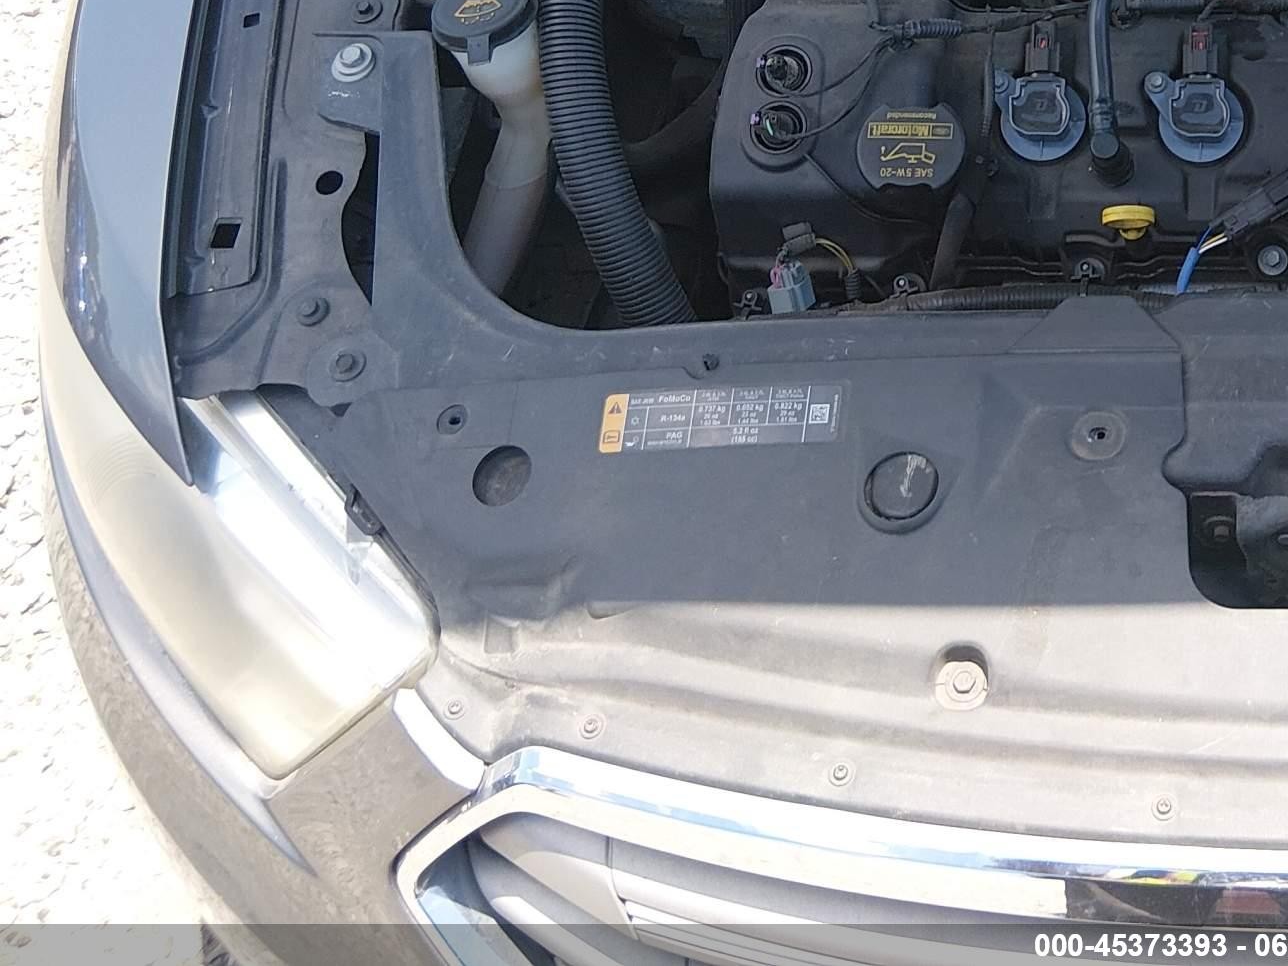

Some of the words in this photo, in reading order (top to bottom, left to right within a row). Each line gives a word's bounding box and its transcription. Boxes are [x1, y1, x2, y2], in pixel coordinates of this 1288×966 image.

[872, 125, 929, 137] Motorcraft
[880, 167, 912, 178] 5W-20
[914, 168, 934, 178] SAE
[665, 431, 683, 439] PAG
